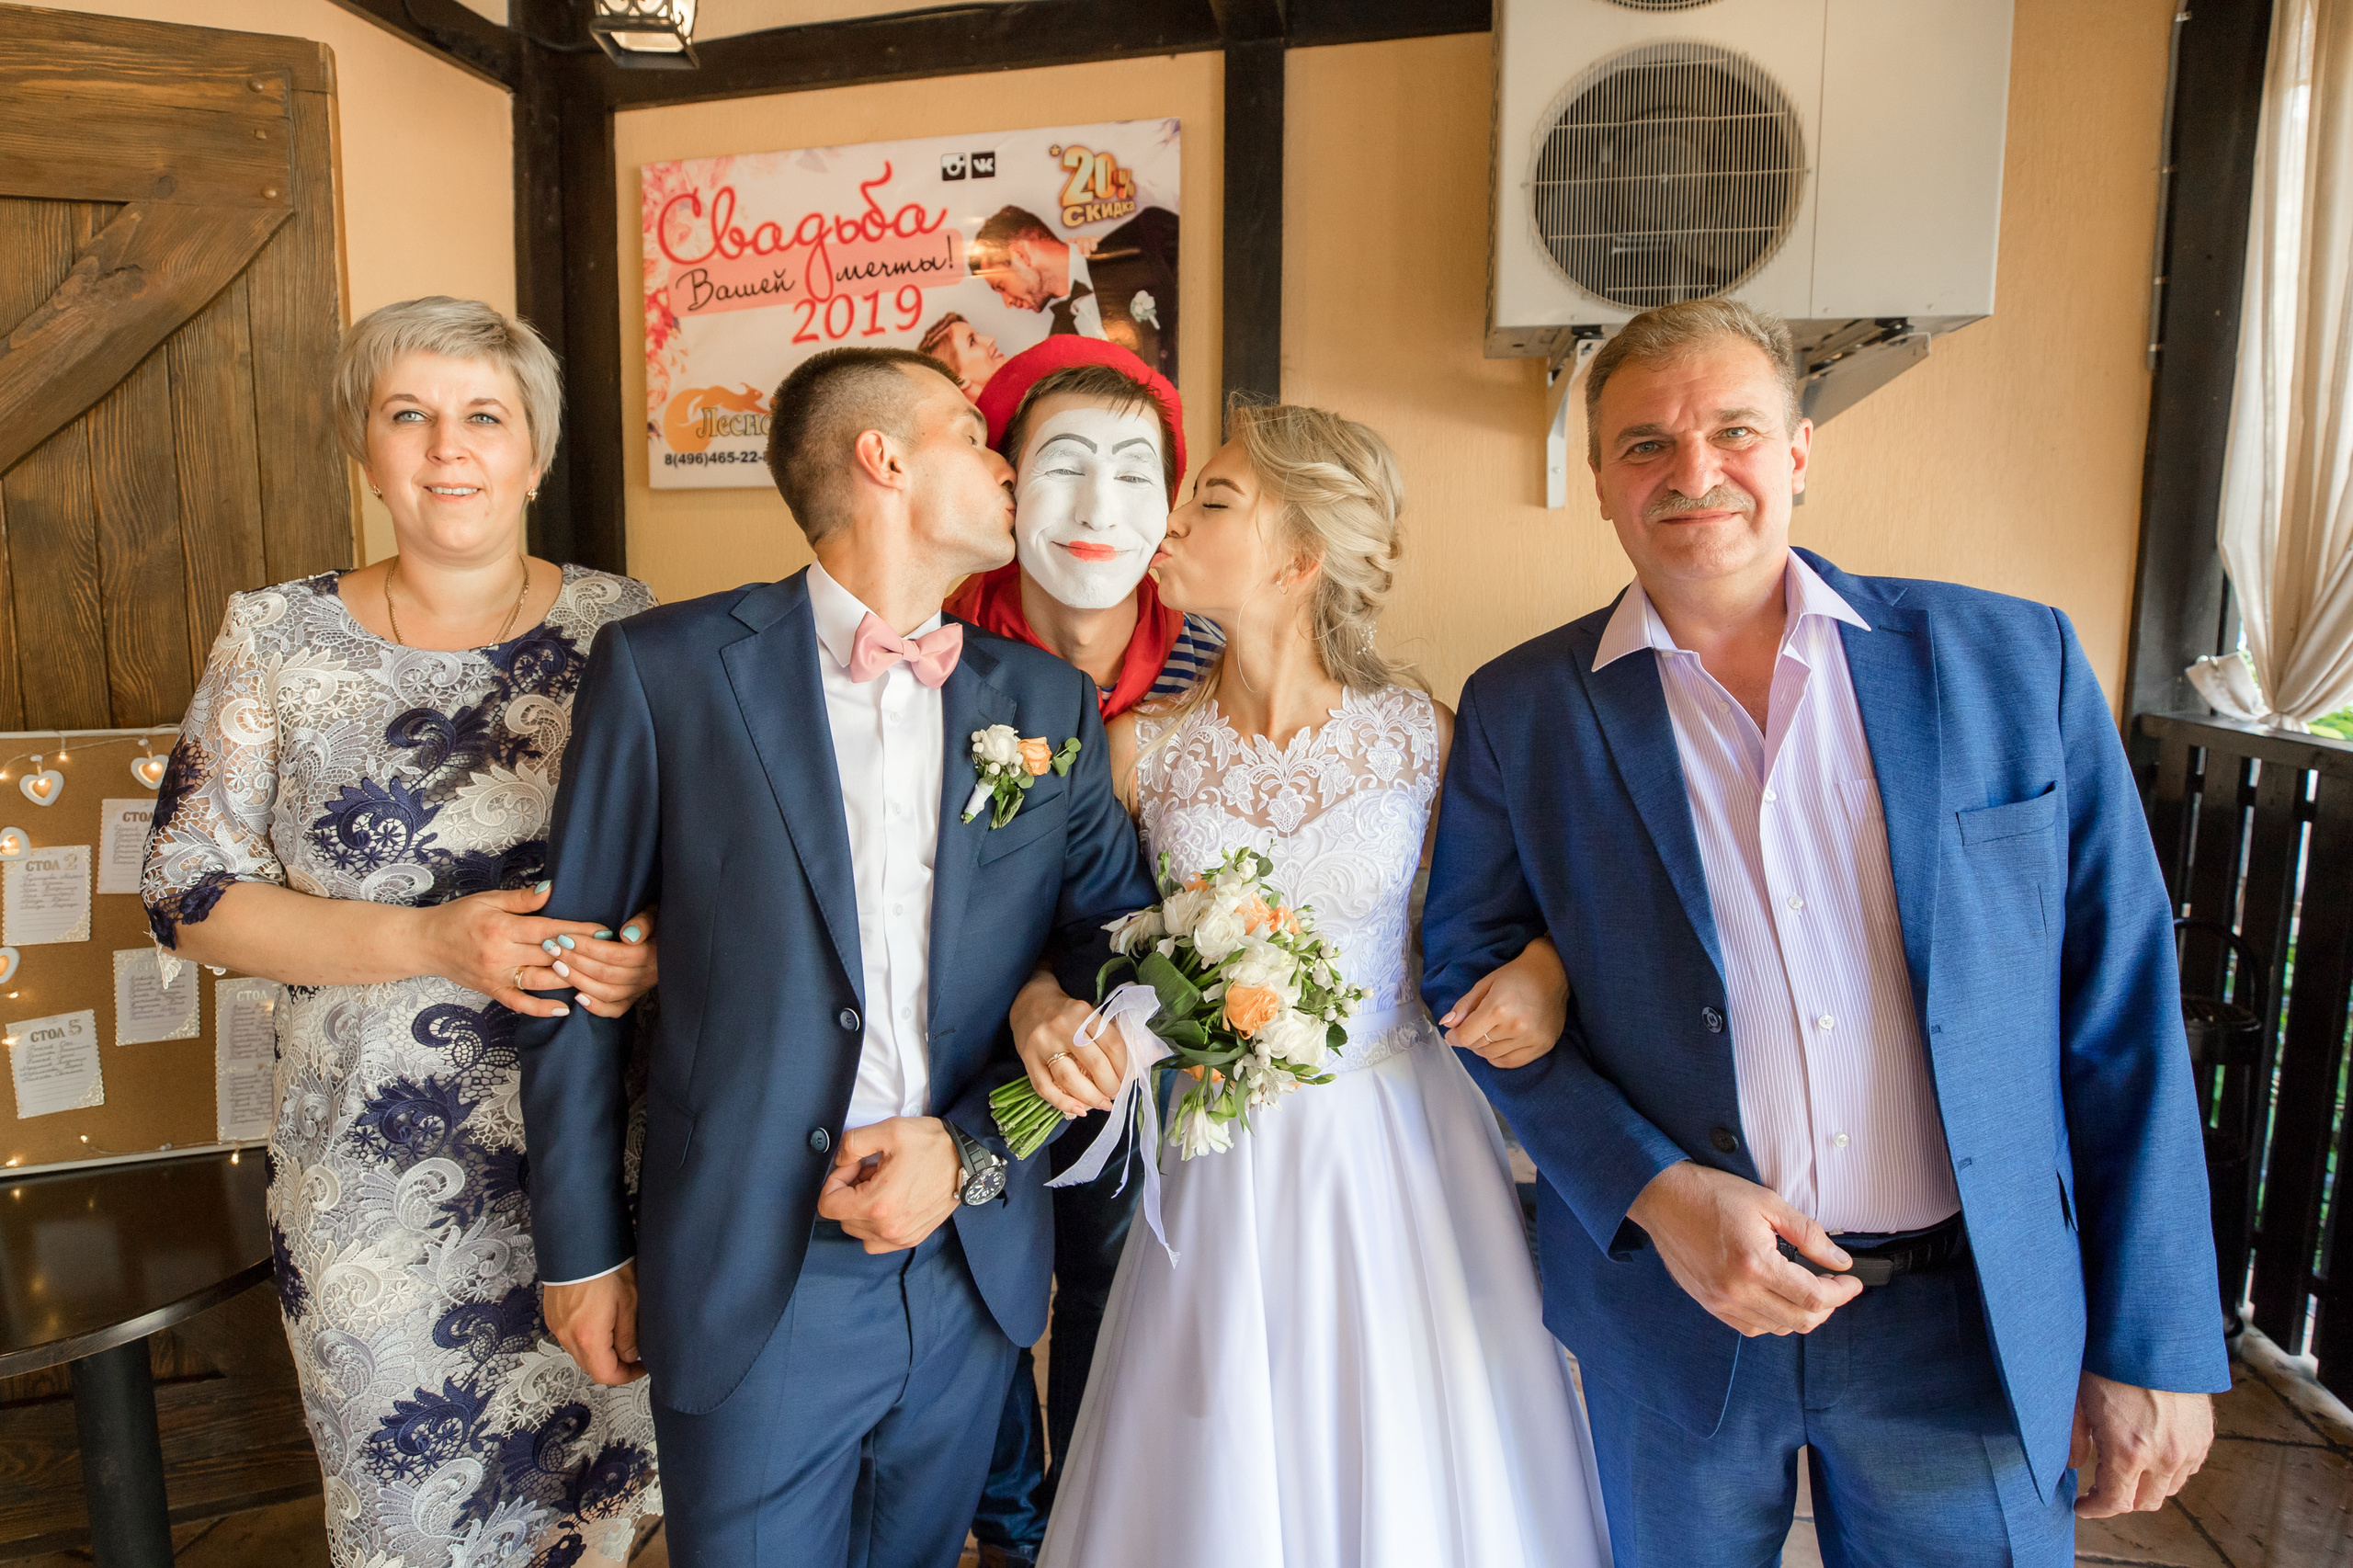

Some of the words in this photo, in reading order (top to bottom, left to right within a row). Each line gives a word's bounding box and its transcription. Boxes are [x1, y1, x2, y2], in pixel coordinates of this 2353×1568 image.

[656, 159, 949, 303] Свадьба
[675, 267, 796, 312] Вашей
[835, 234, 954, 283] мечты!
[790, 283, 924, 345] 2019
[696, 406, 772, 438] Лесно
[664, 450, 767, 468] 8(496)465-22-
[25, 859, 61, 872] СТОЛ
[63, 853, 78, 870] 2
[236, 989, 267, 1002] СТОЛ
[30, 1027, 65, 1043] СТОЛ
[68, 1018, 83, 1036] 5
